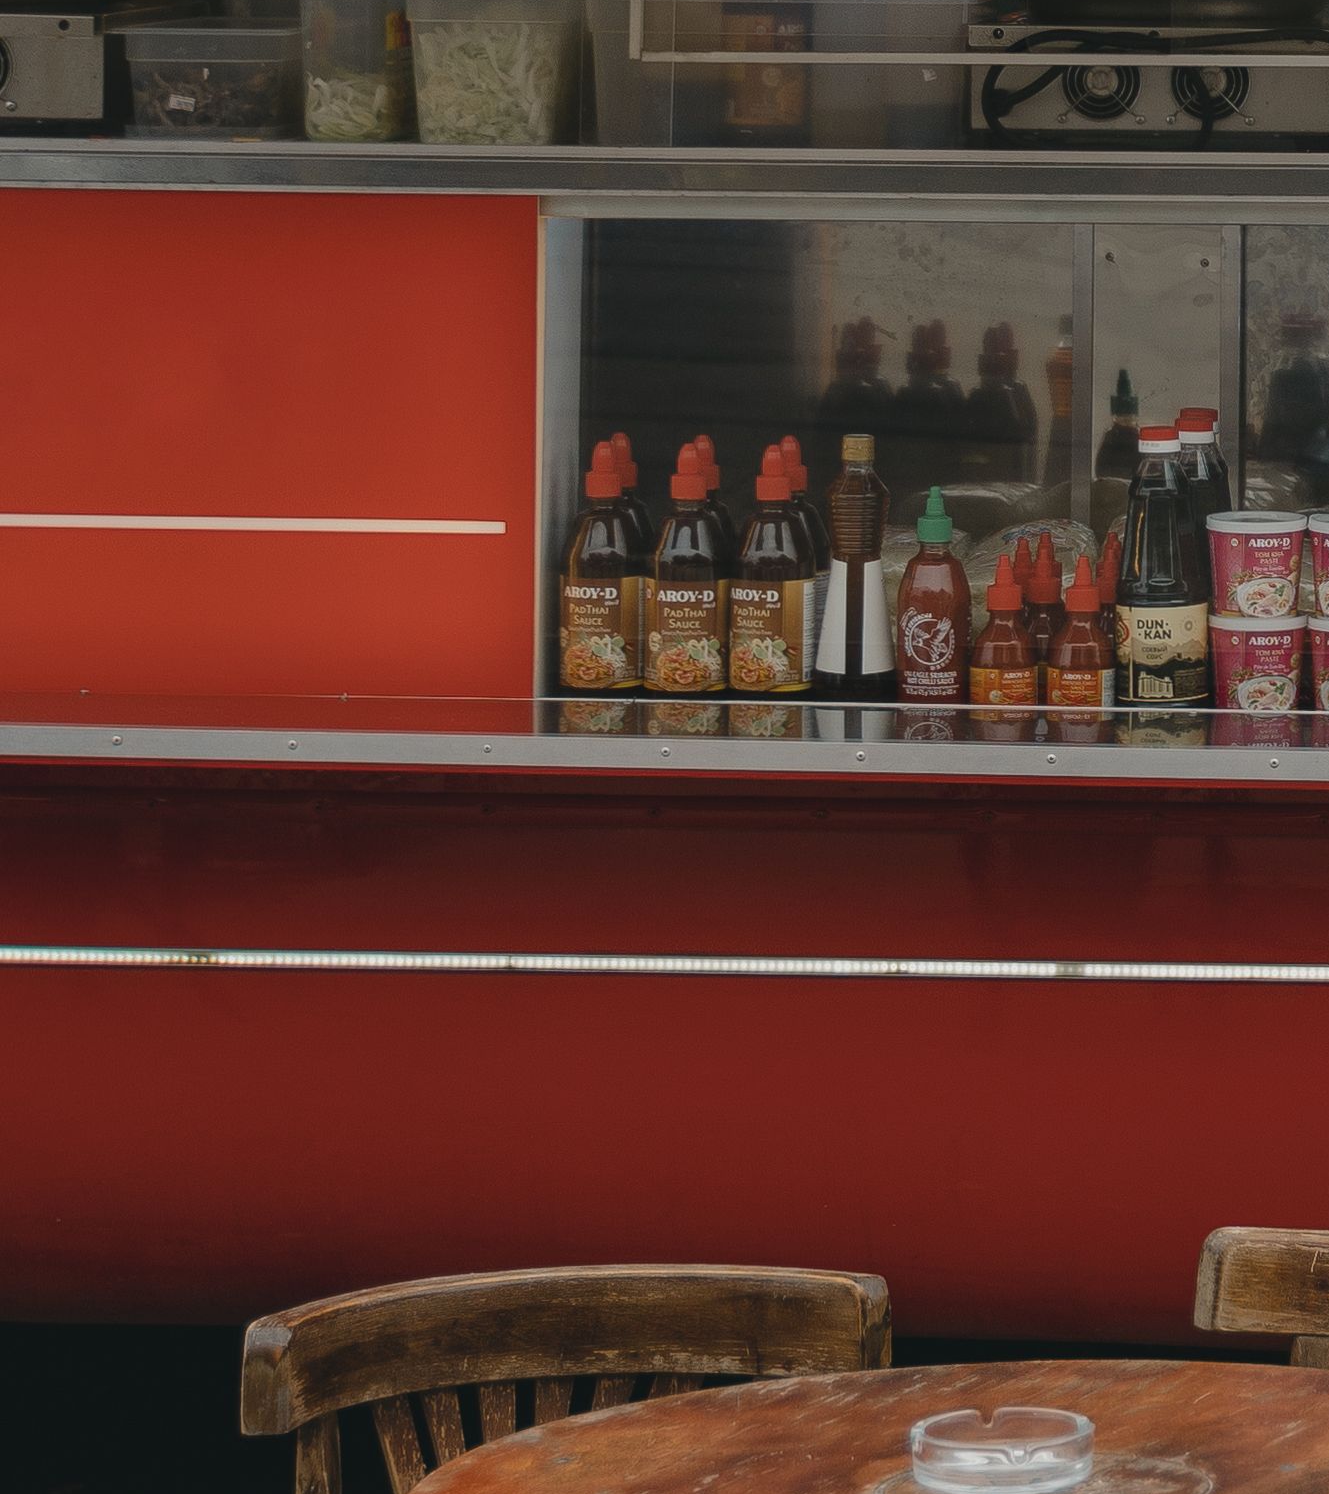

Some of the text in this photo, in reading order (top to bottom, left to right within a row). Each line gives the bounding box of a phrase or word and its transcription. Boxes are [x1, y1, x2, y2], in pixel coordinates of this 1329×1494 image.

[1248, 538, 1290, 548] AROY-D
[564, 586, 618, 600] AROY-D
[657, 590, 714, 603] AROY-D
[574, 615, 603, 626] SAUCE
[669, 619, 701, 629] SAUCE
[1249, 635, 1291, 646] AROY-D
